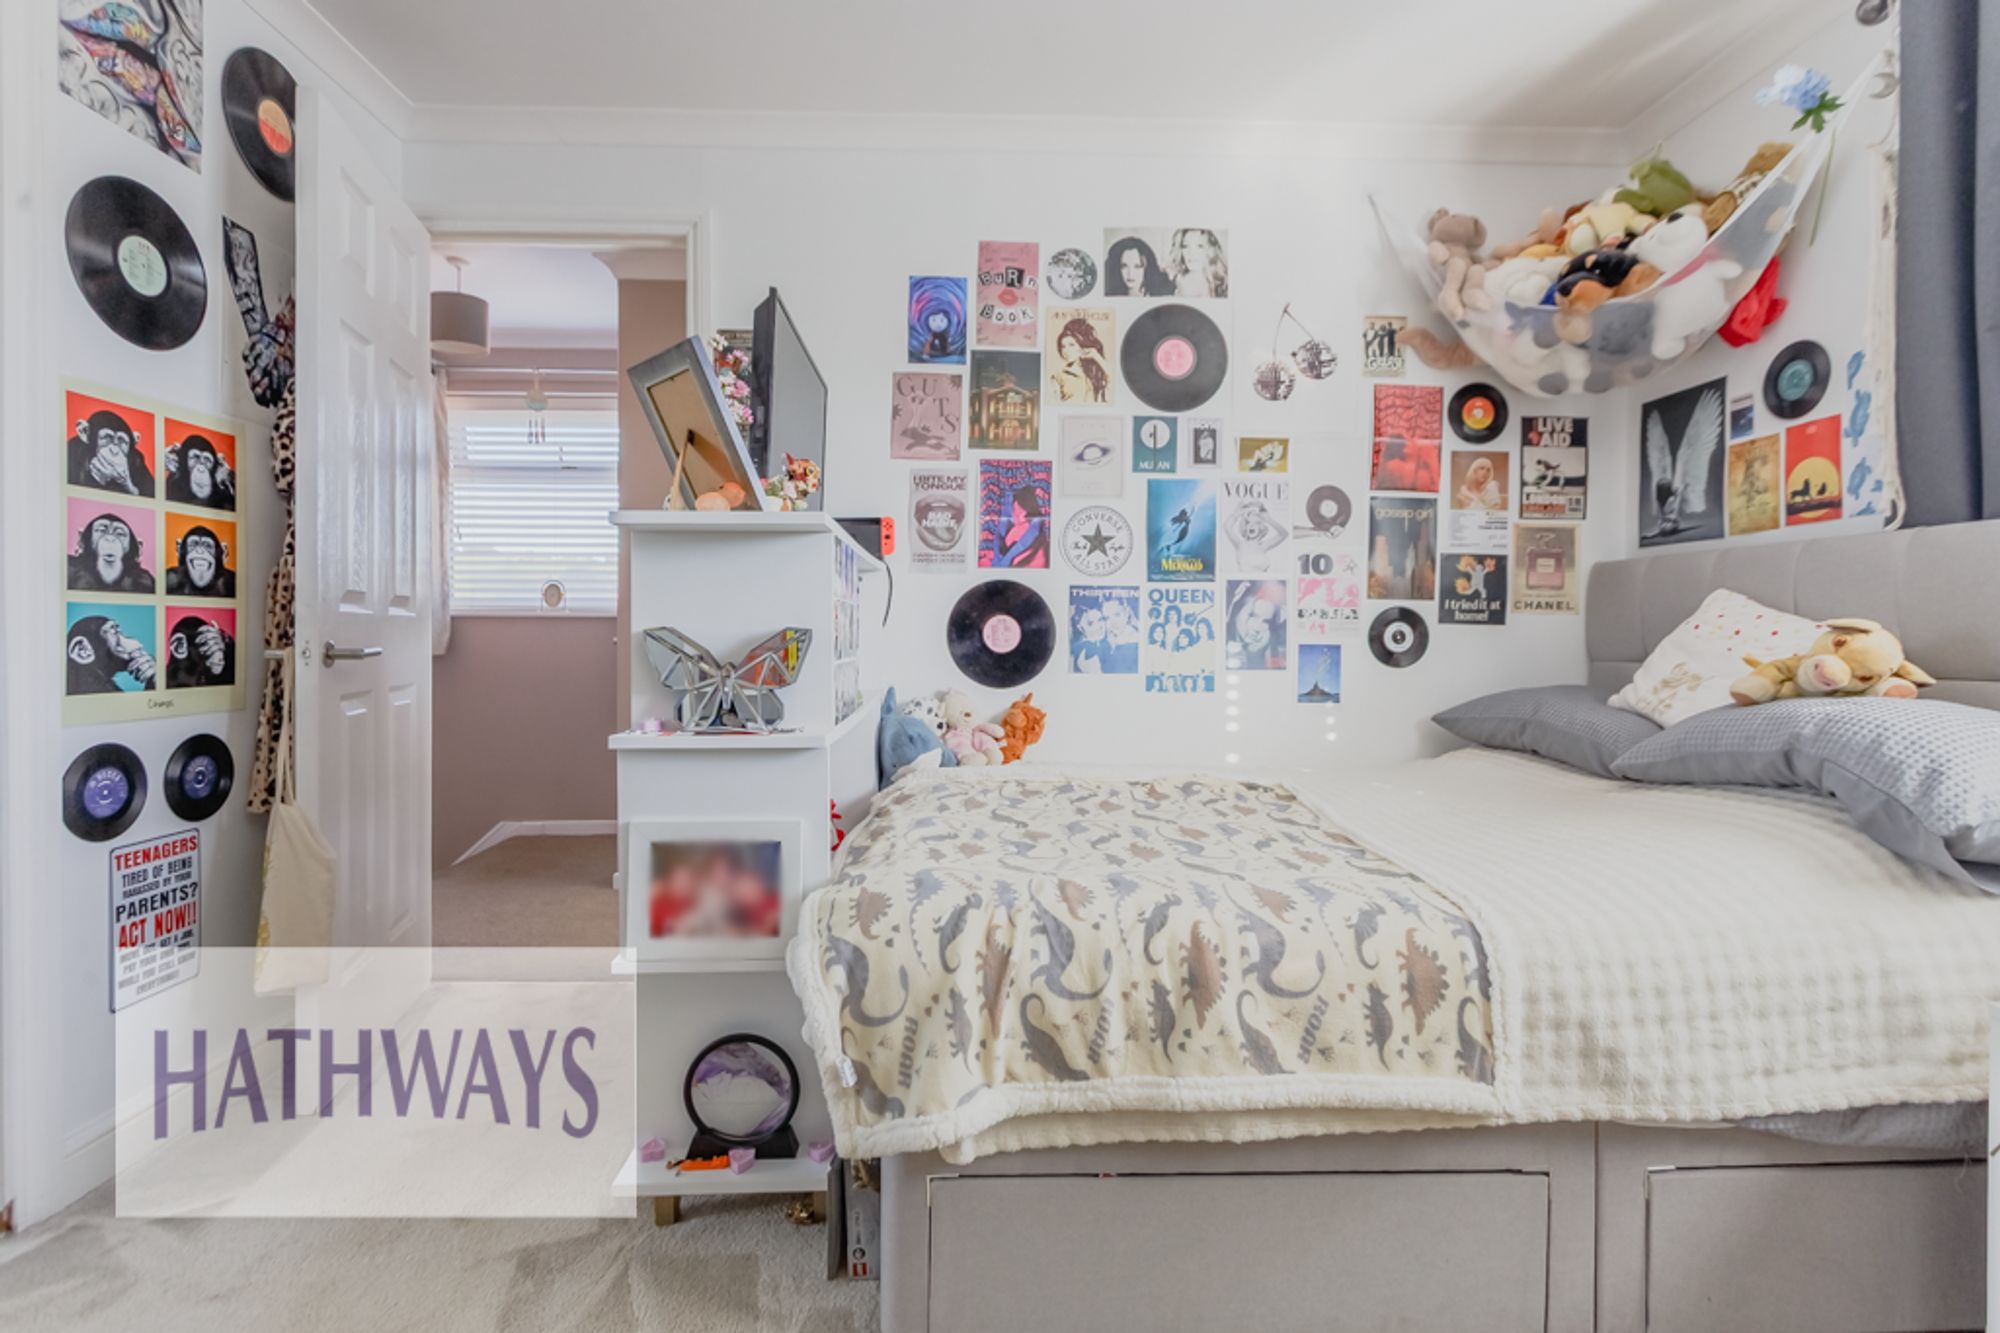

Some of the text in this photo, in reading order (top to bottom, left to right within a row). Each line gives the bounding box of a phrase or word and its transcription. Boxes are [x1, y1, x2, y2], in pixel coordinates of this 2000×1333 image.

[1537, 417, 1574, 433] LIVE
[1540, 433, 1571, 449] AID
[1139, 460, 1170, 470] MUAN
[913, 482, 967, 491] TONGUE
[946, 475, 967, 484] MY
[1224, 482, 1288, 500] VOGUE
[1072, 511, 1123, 534] CONVERSE
[1095, 555, 1120, 571] STAR
[1297, 553, 1334, 574] 10
[1147, 588, 1215, 606] QUEEN
[1450, 599, 1478, 610] tried
[1489, 600, 1501, 610] at
[1513, 601, 1574, 611] CHANEL
[114, 835, 198, 871] TEENAGERS
[122, 857, 193, 888] TIRED OF BEING
[116, 882, 198, 923] PARENTS?
[119, 901, 197, 949] ACT NOW!!
[1297, 994, 1329, 1065] ROAR
[898, 1016, 918, 1090] ROAR
